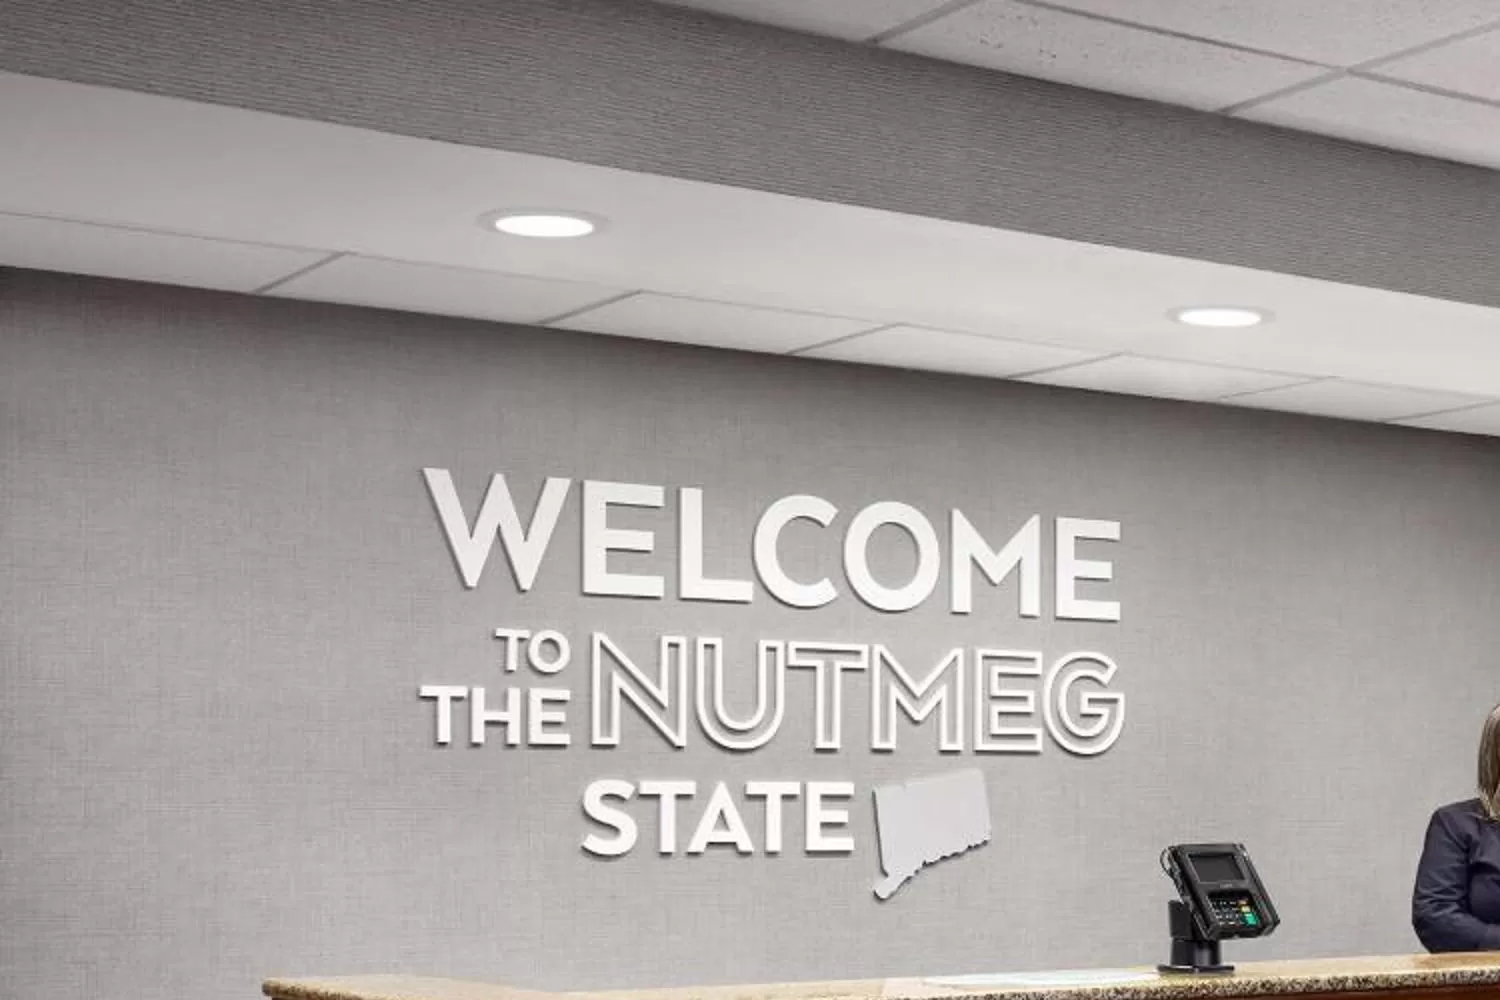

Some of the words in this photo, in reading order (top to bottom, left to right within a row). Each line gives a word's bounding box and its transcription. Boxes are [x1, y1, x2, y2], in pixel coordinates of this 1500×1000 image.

[422, 467, 1121, 622] WELCOME
[419, 685, 571, 746] THE
[591, 632, 1125, 755] NUTMEG
[495, 628, 570, 673] TO
[580, 780, 855, 856] STATE
